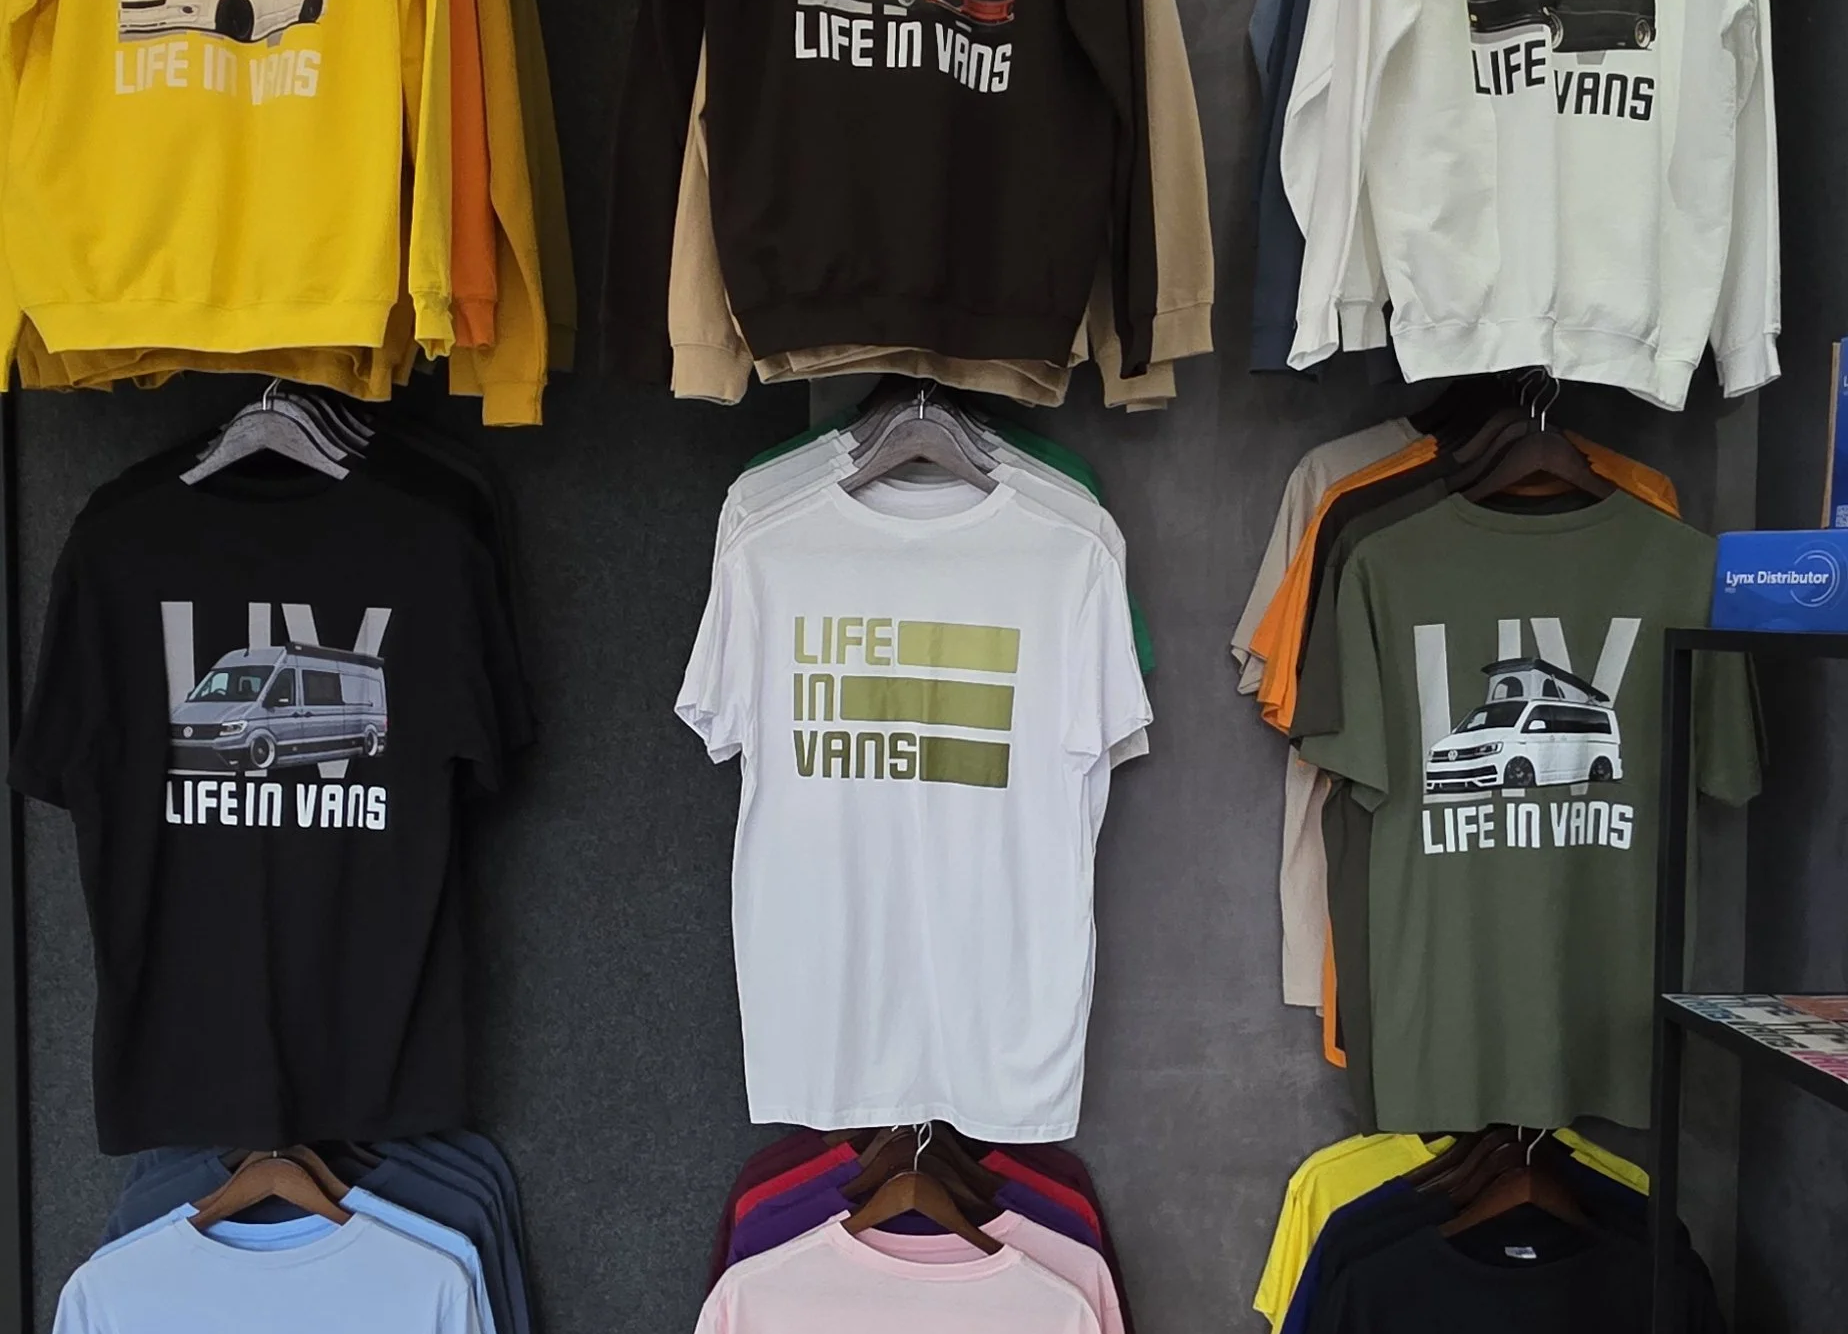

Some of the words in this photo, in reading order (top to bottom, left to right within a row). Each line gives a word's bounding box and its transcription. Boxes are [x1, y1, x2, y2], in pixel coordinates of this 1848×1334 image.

[115, 41, 189, 95] LIFE
[203, 43, 238, 97] IN
[249, 48, 321, 106] VANS
[795, 11, 874, 67] LIFE
[886, 21, 922, 68] IN
[935, 21, 1012, 93] VANS
[1471, 39, 1547, 96] LIFE
[1554, 69, 1655, 121] VANS
[1726, 571, 1755, 587] Lynx
[1757, 570, 1829, 585] Distributor
[794, 616, 893, 666] LIFE
[793, 673, 835, 722] IN
[793, 730, 917, 780] VANS
[165, 780, 238, 826] LIFE
[245, 782, 282, 827] IN
[296, 783, 387, 830] VANS
[1422, 804, 1495, 854] LIFE
[1506, 802, 1540, 848] IN
[1550, 801, 1634, 850] VANS
